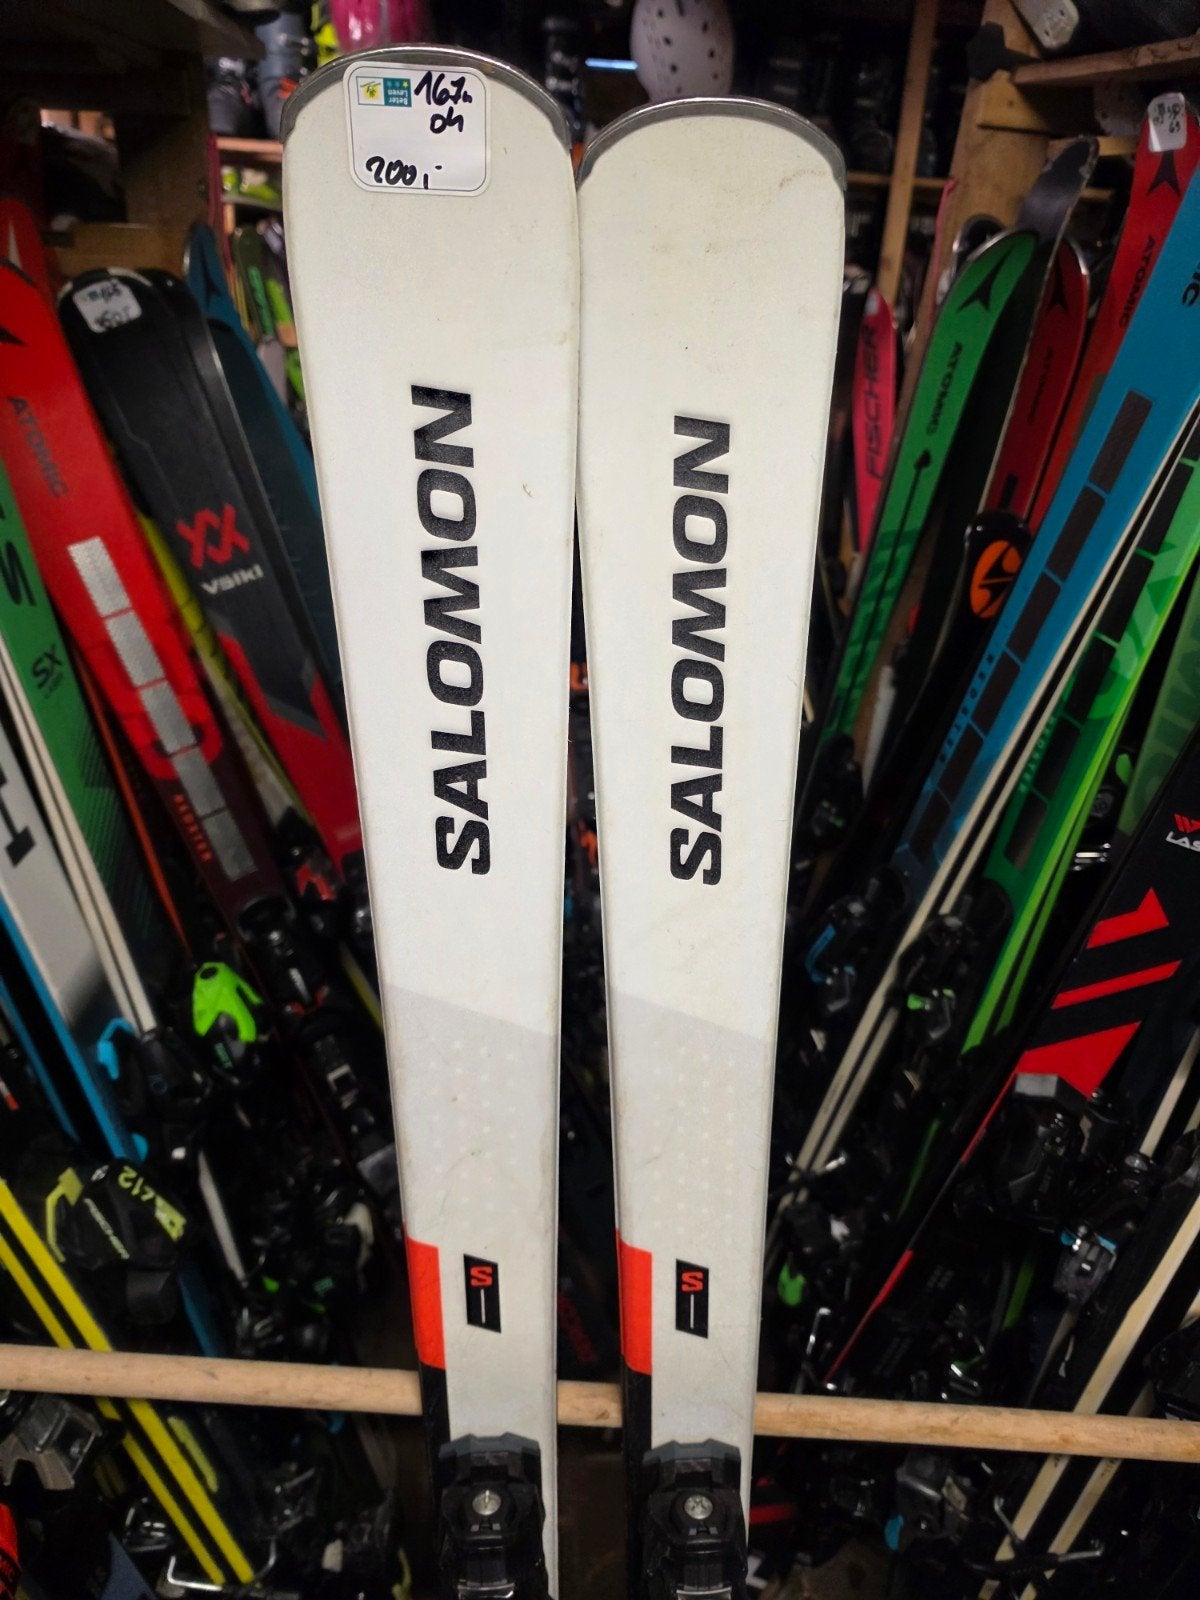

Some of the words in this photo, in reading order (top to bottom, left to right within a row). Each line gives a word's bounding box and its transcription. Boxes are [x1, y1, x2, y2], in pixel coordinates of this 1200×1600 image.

[388, 97, 409, 106] Beter
[10, 395, 70, 498] ATOMIC
[411, 384, 491, 876] SALOMON
[669, 415, 731, 886] SALOMON
[469, 1265, 494, 1288] S
[680, 1270, 704, 1293] S
